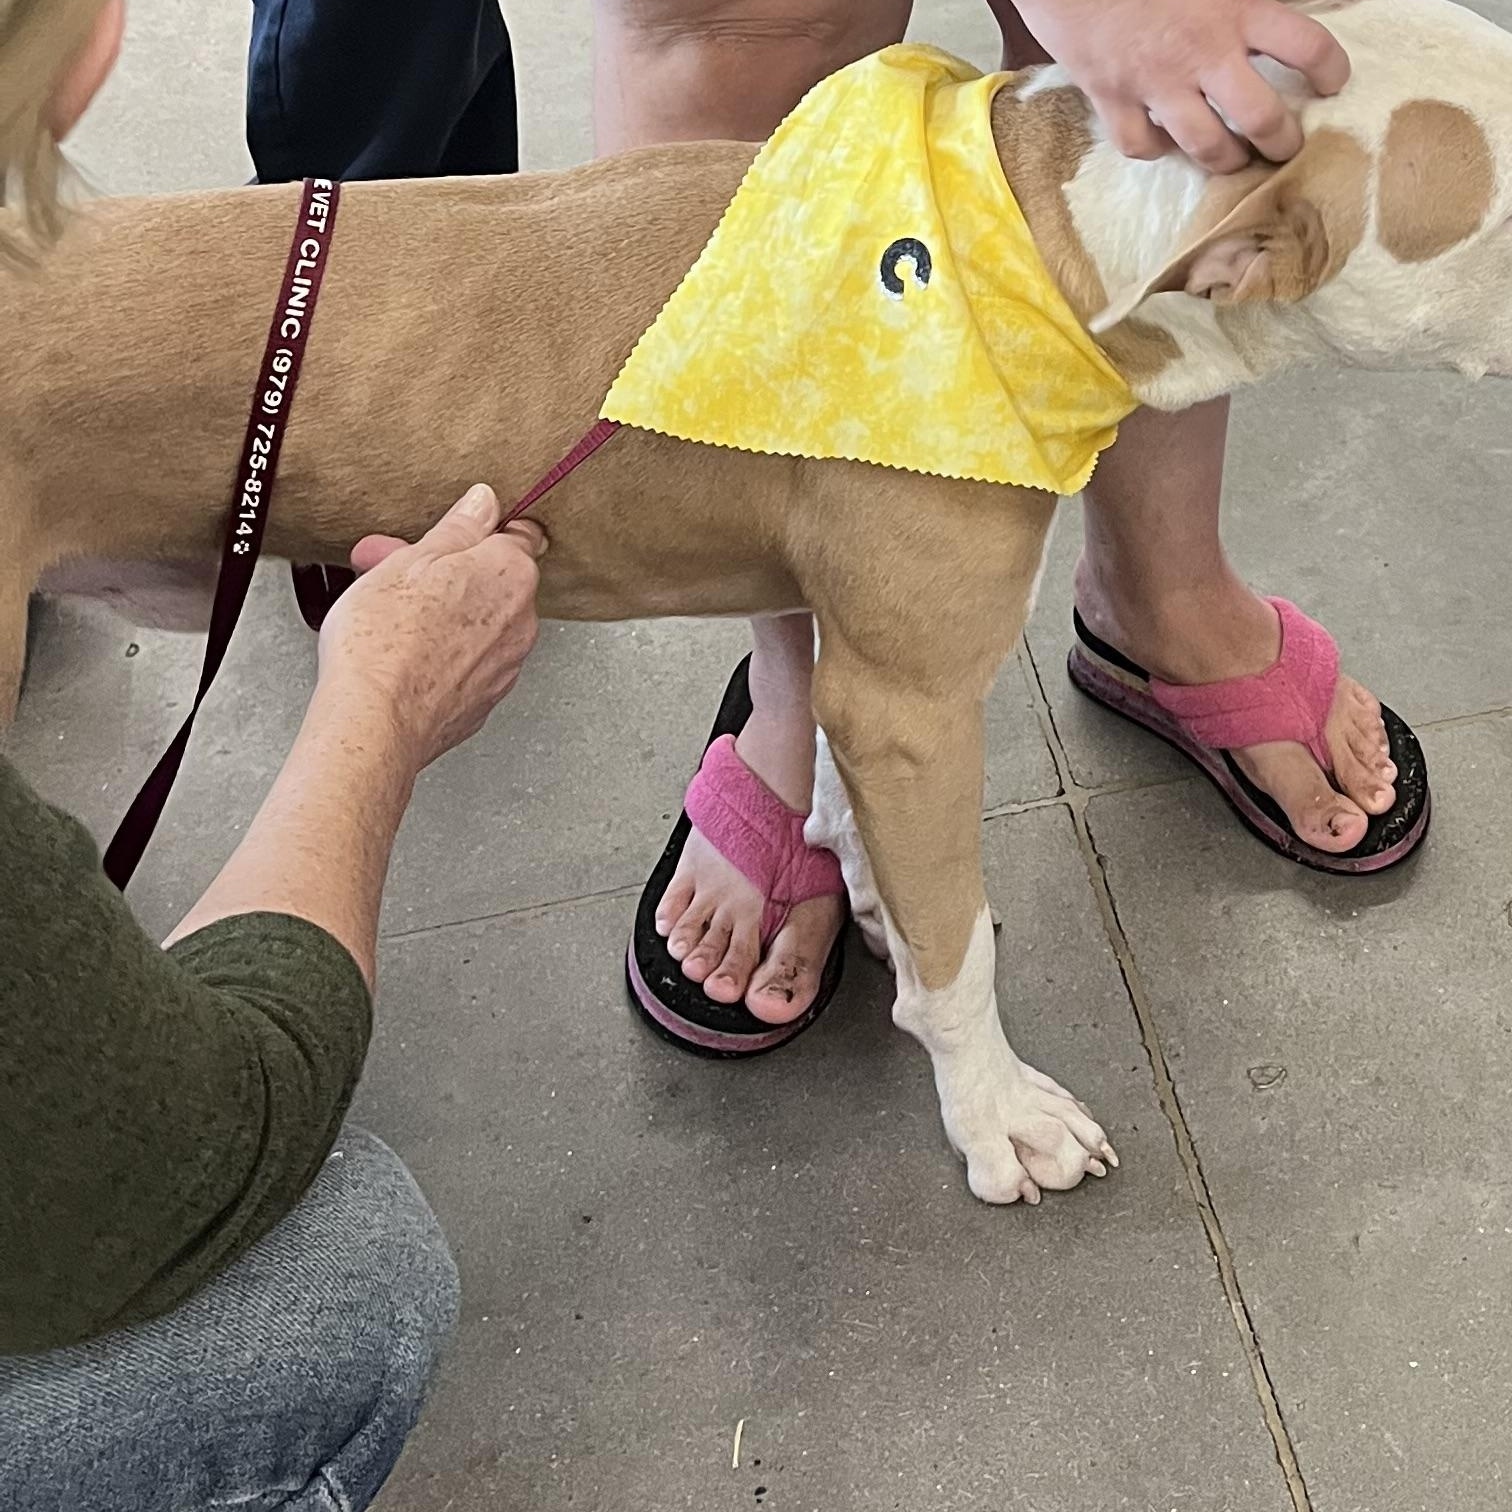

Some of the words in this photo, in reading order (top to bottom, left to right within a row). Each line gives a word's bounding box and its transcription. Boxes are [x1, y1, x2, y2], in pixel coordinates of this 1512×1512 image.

[280, 237, 320, 340] CLINIC
[261, 348, 294, 415] (979)
[235, 423, 276, 536] 725-8214
